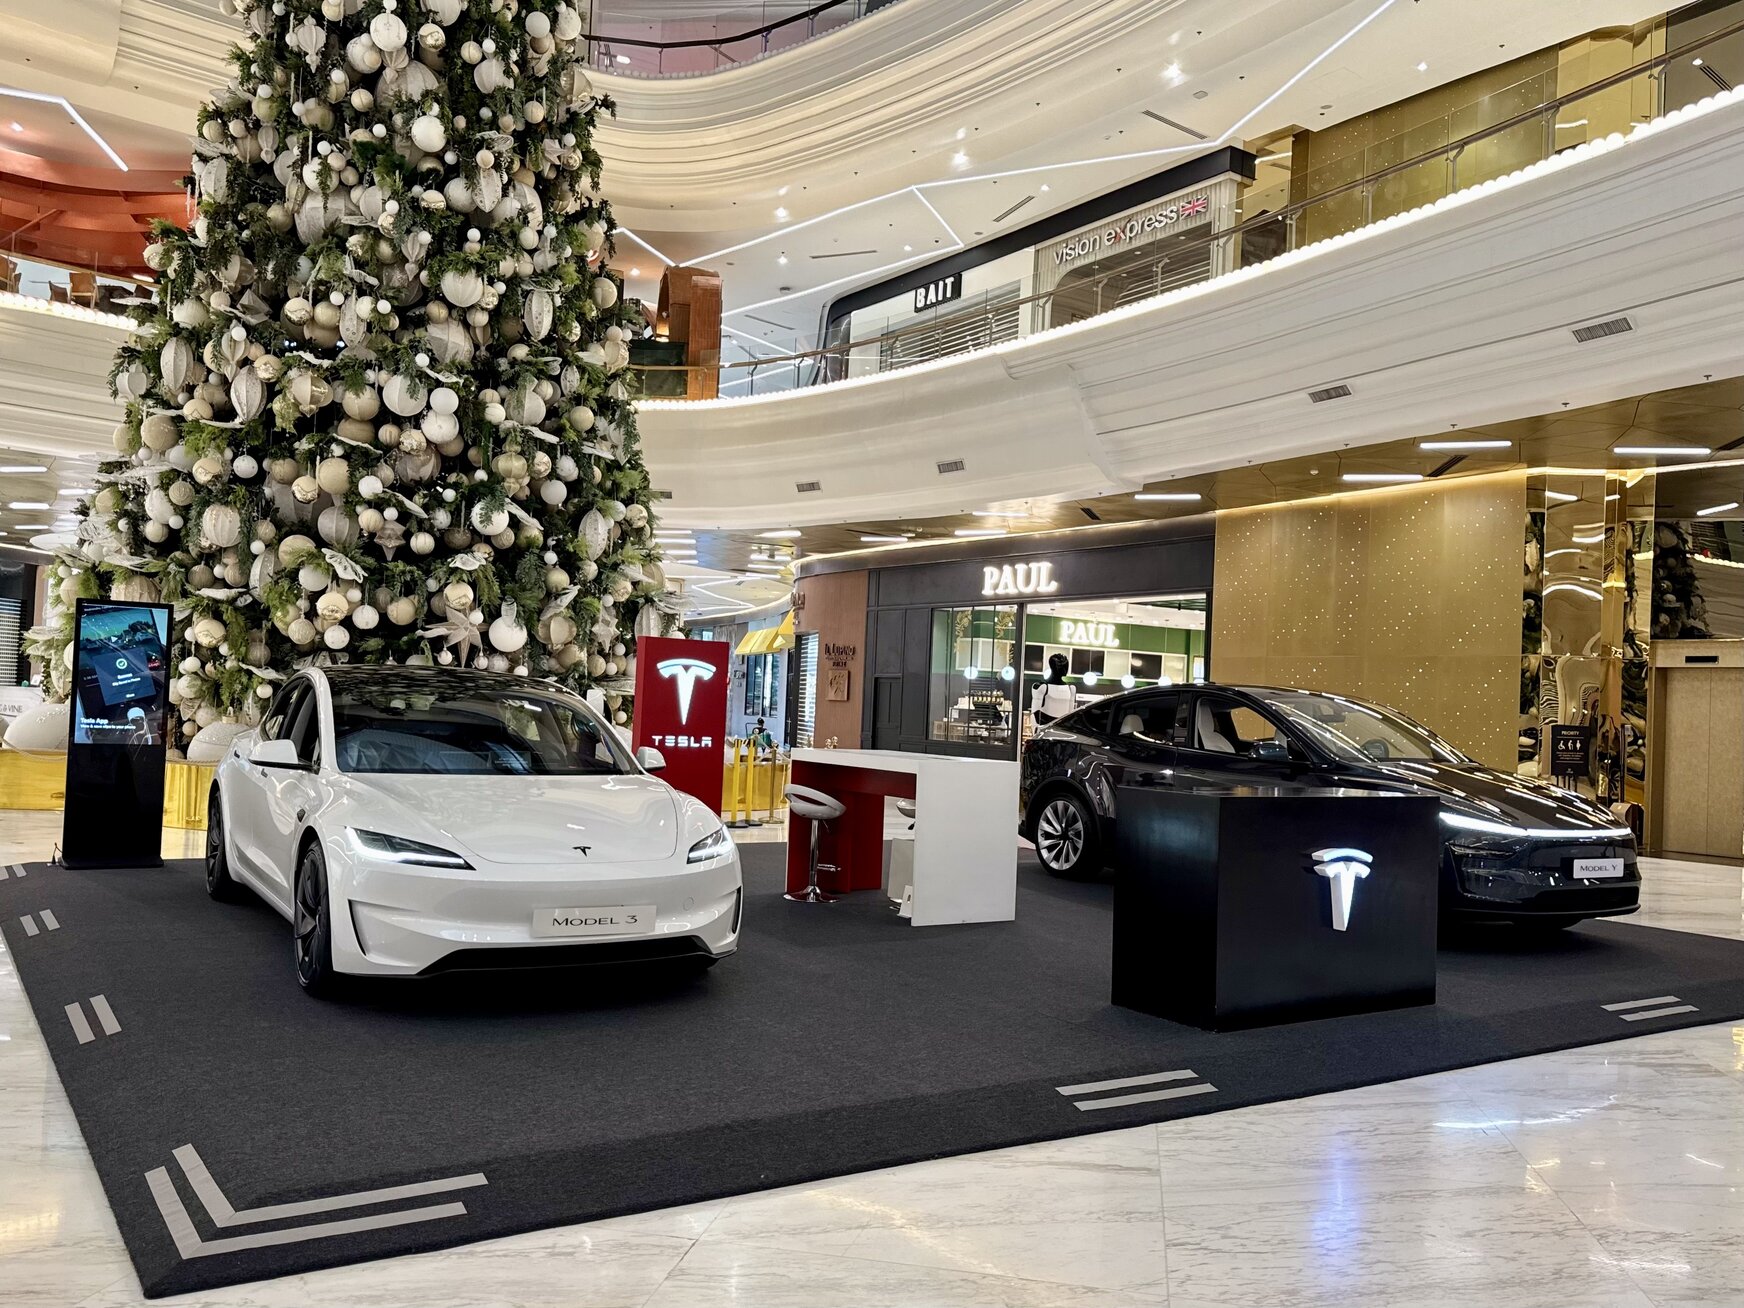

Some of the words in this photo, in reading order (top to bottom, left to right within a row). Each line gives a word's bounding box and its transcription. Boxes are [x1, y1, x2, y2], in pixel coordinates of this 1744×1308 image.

[1053, 234, 1100, 265] vision
[1104, 204, 1178, 243] express
[915, 277, 954, 308] BAIT
[981, 561, 1058, 595] PAUL
[1059, 620, 1120, 647] PAUL
[651, 735, 712, 748] TESLA
[552, 917, 620, 927] MODEL
[625, 915, 638, 924] 3
